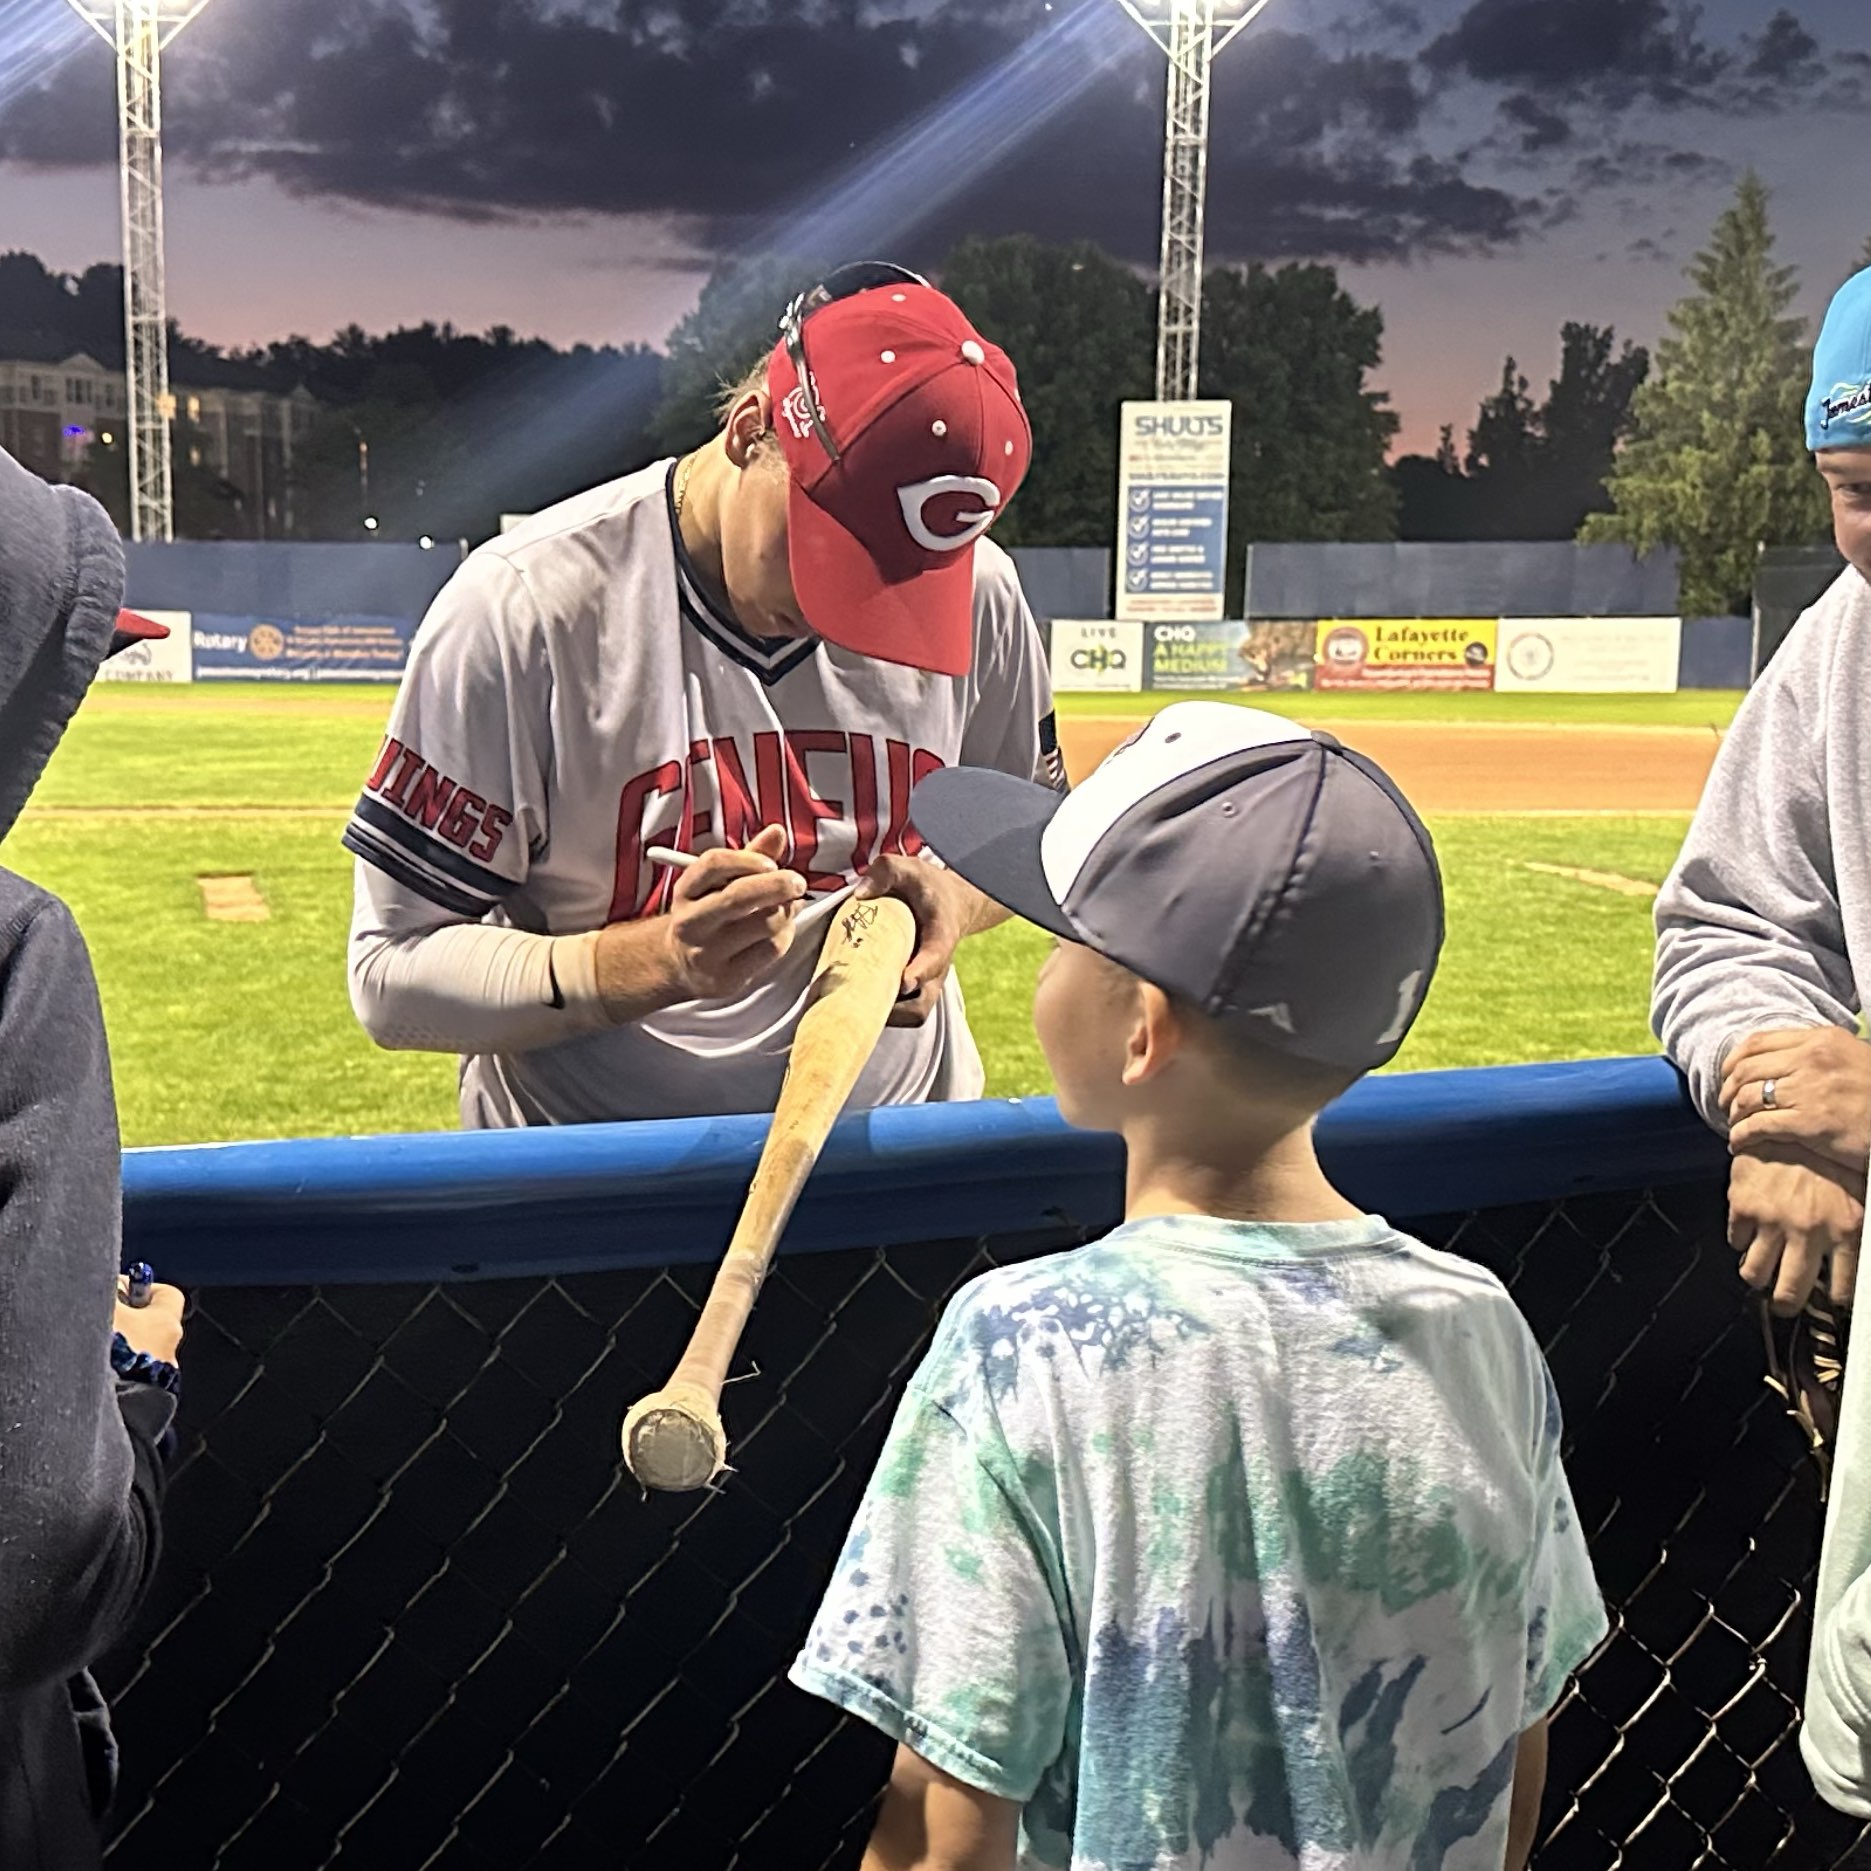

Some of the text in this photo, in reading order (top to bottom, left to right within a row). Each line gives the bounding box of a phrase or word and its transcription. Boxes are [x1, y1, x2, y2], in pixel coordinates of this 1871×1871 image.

[1134, 415, 1224, 436] SHULTS
[194, 630, 248, 653] Rotary
[1375, 626, 1469, 646] Lafayette
[1374, 647, 1457, 661] Corners
